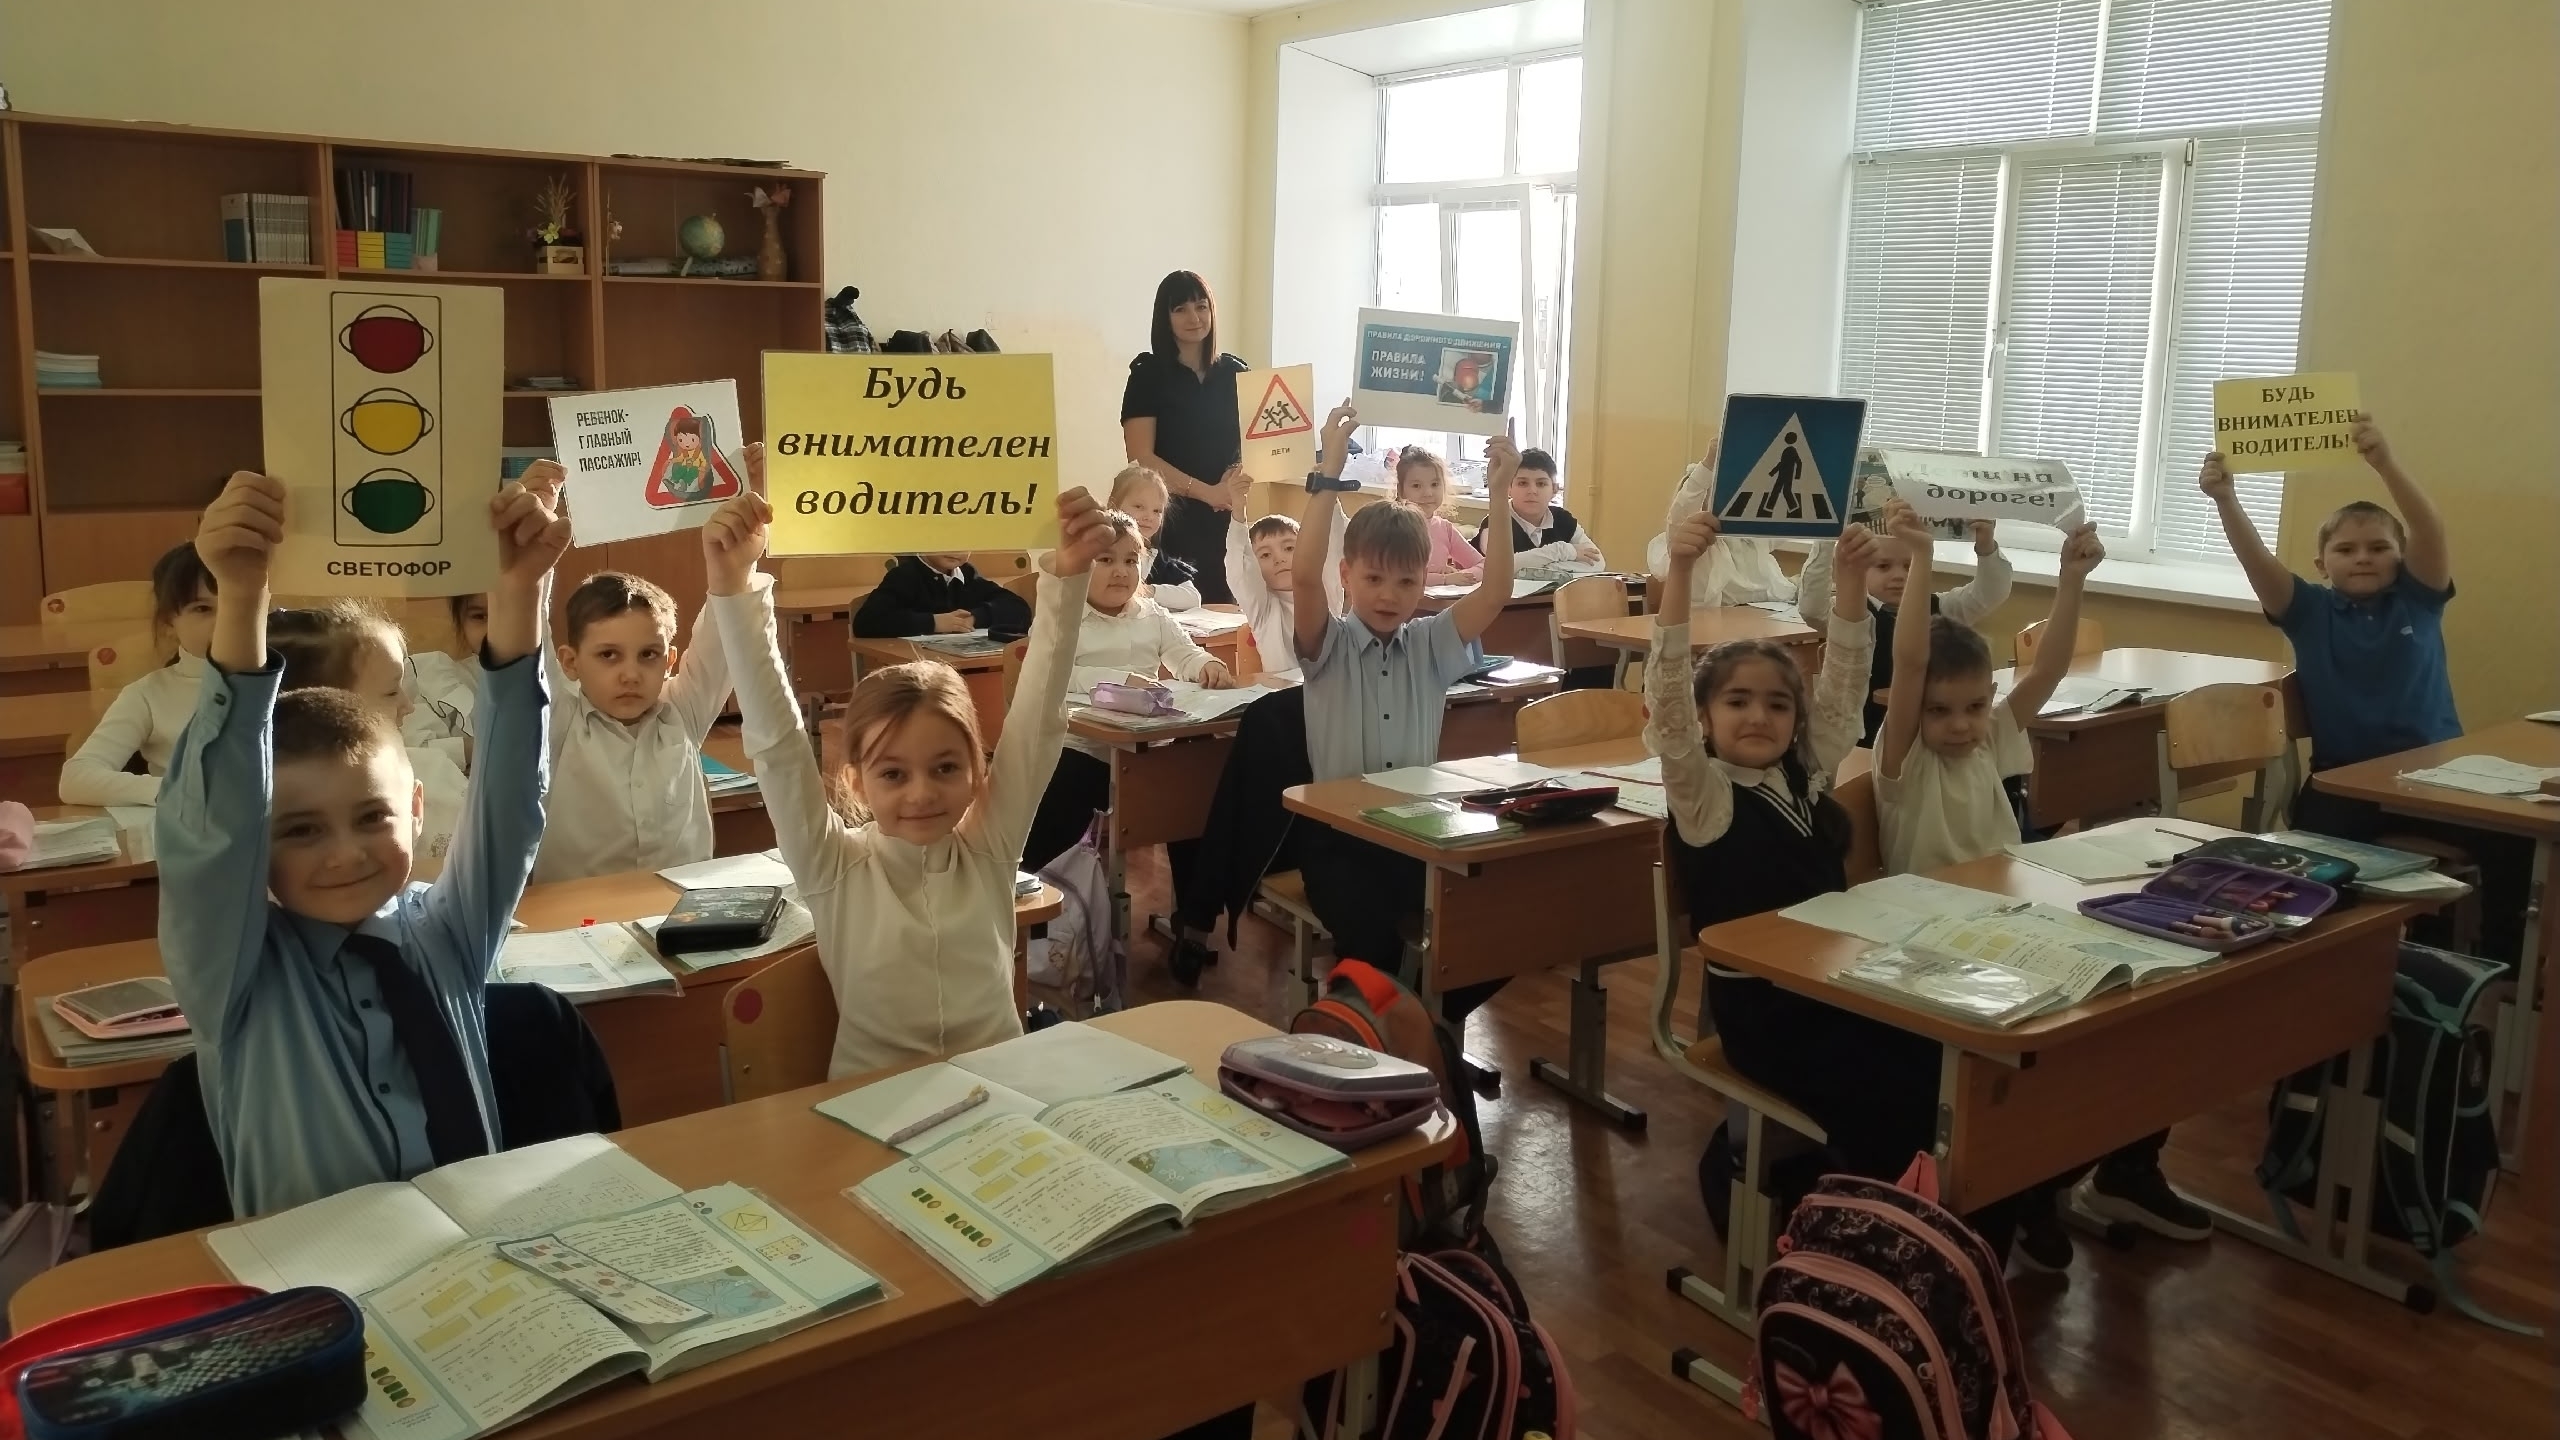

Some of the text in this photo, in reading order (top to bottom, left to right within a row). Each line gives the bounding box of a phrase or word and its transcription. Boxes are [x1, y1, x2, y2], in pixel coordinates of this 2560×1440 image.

[1367, 330, 1402, 341] ПРАВИЛА
[1403, 334, 1452, 345] ДОРОЖНОГО
[1371, 350, 1426, 365] ПРАВИЛА
[1370, 365, 1425, 381] ЖИЗНИ!
[863, 367, 967, 408] Будь
[2262, 386, 2315, 404] БУДЬ
[576, 409, 629, 428] РЕБЕНОК-
[578, 427, 632, 450] ГЛАВНЫЙ
[777, 432, 1050, 458] внимателен
[2232, 433, 2349, 456] ВОДИТЕЛЬ!
[1271, 447, 1290, 456] ДЕТИ
[579, 451, 641, 472] ПАССАЖИР!
[2013, 471, 2054, 484] на
[795, 481, 1037, 515] водитель!
[1926, 484, 2055, 508] дороге!
[327, 561, 452, 577] СВЕТОФОР
